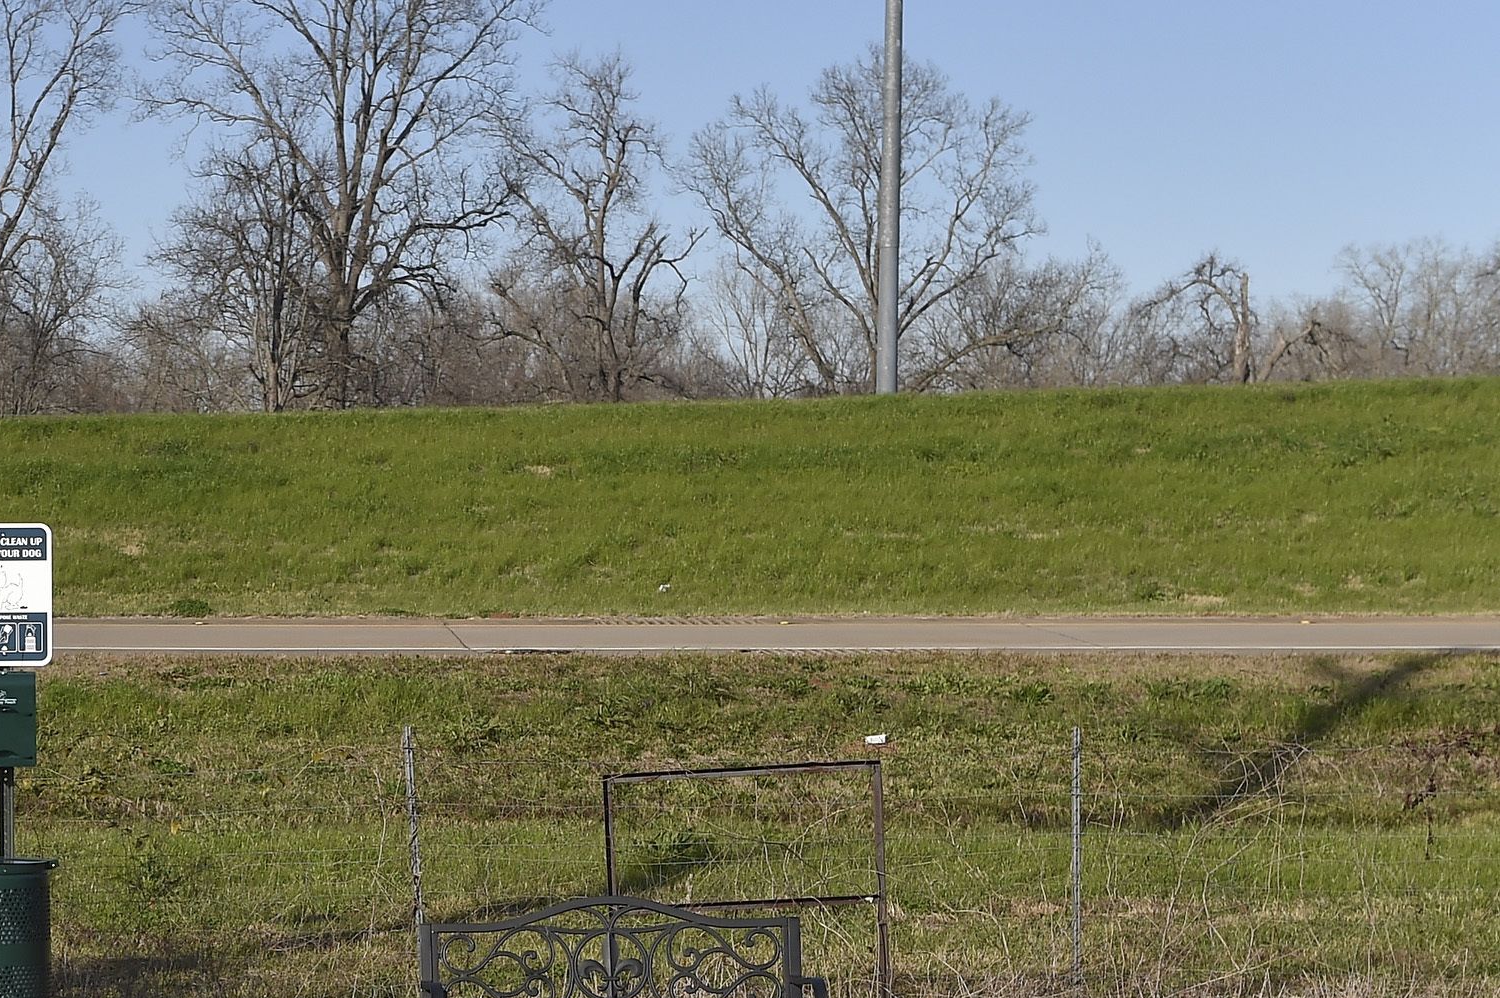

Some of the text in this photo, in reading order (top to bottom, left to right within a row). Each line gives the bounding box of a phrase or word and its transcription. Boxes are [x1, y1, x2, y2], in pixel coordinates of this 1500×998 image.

[0, 537, 28, 546] CLEAN
[29, 537, 43, 546] UP
[22, 549, 42, 558] DOG
